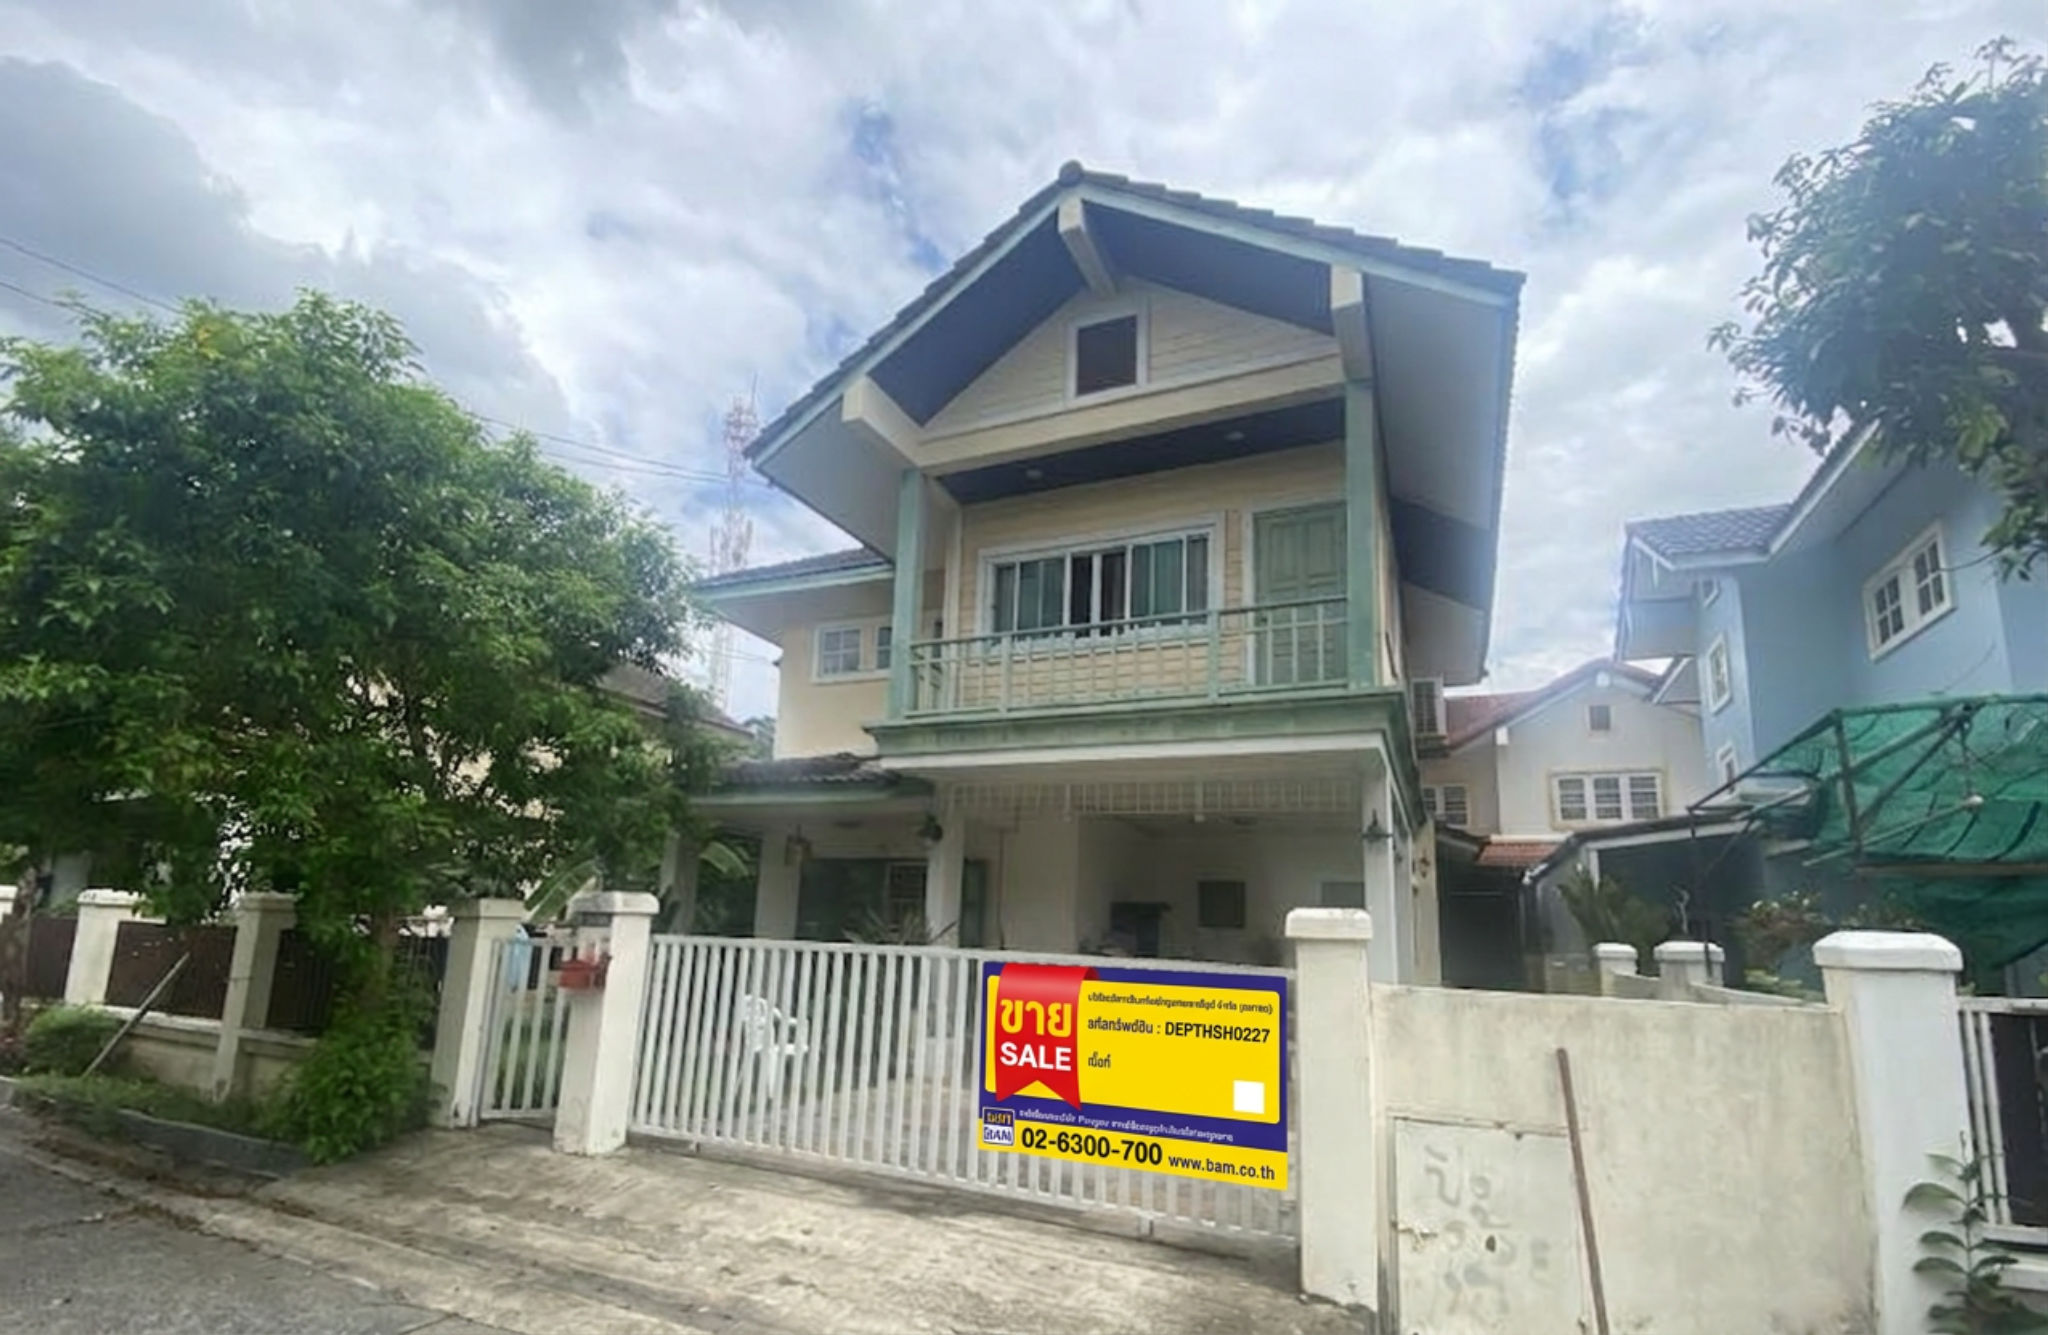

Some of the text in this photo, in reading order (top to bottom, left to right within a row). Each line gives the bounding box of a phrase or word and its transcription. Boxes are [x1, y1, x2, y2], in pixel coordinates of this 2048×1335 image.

[1000, 999, 1072, 1038] ขาย
[1165, 1021, 1271, 1044] DEPTHSH0227
[1000, 1041, 1072, 1072] SALE
[1021, 1127, 1276, 1180] 02-6300-700 www.bam.co.th
